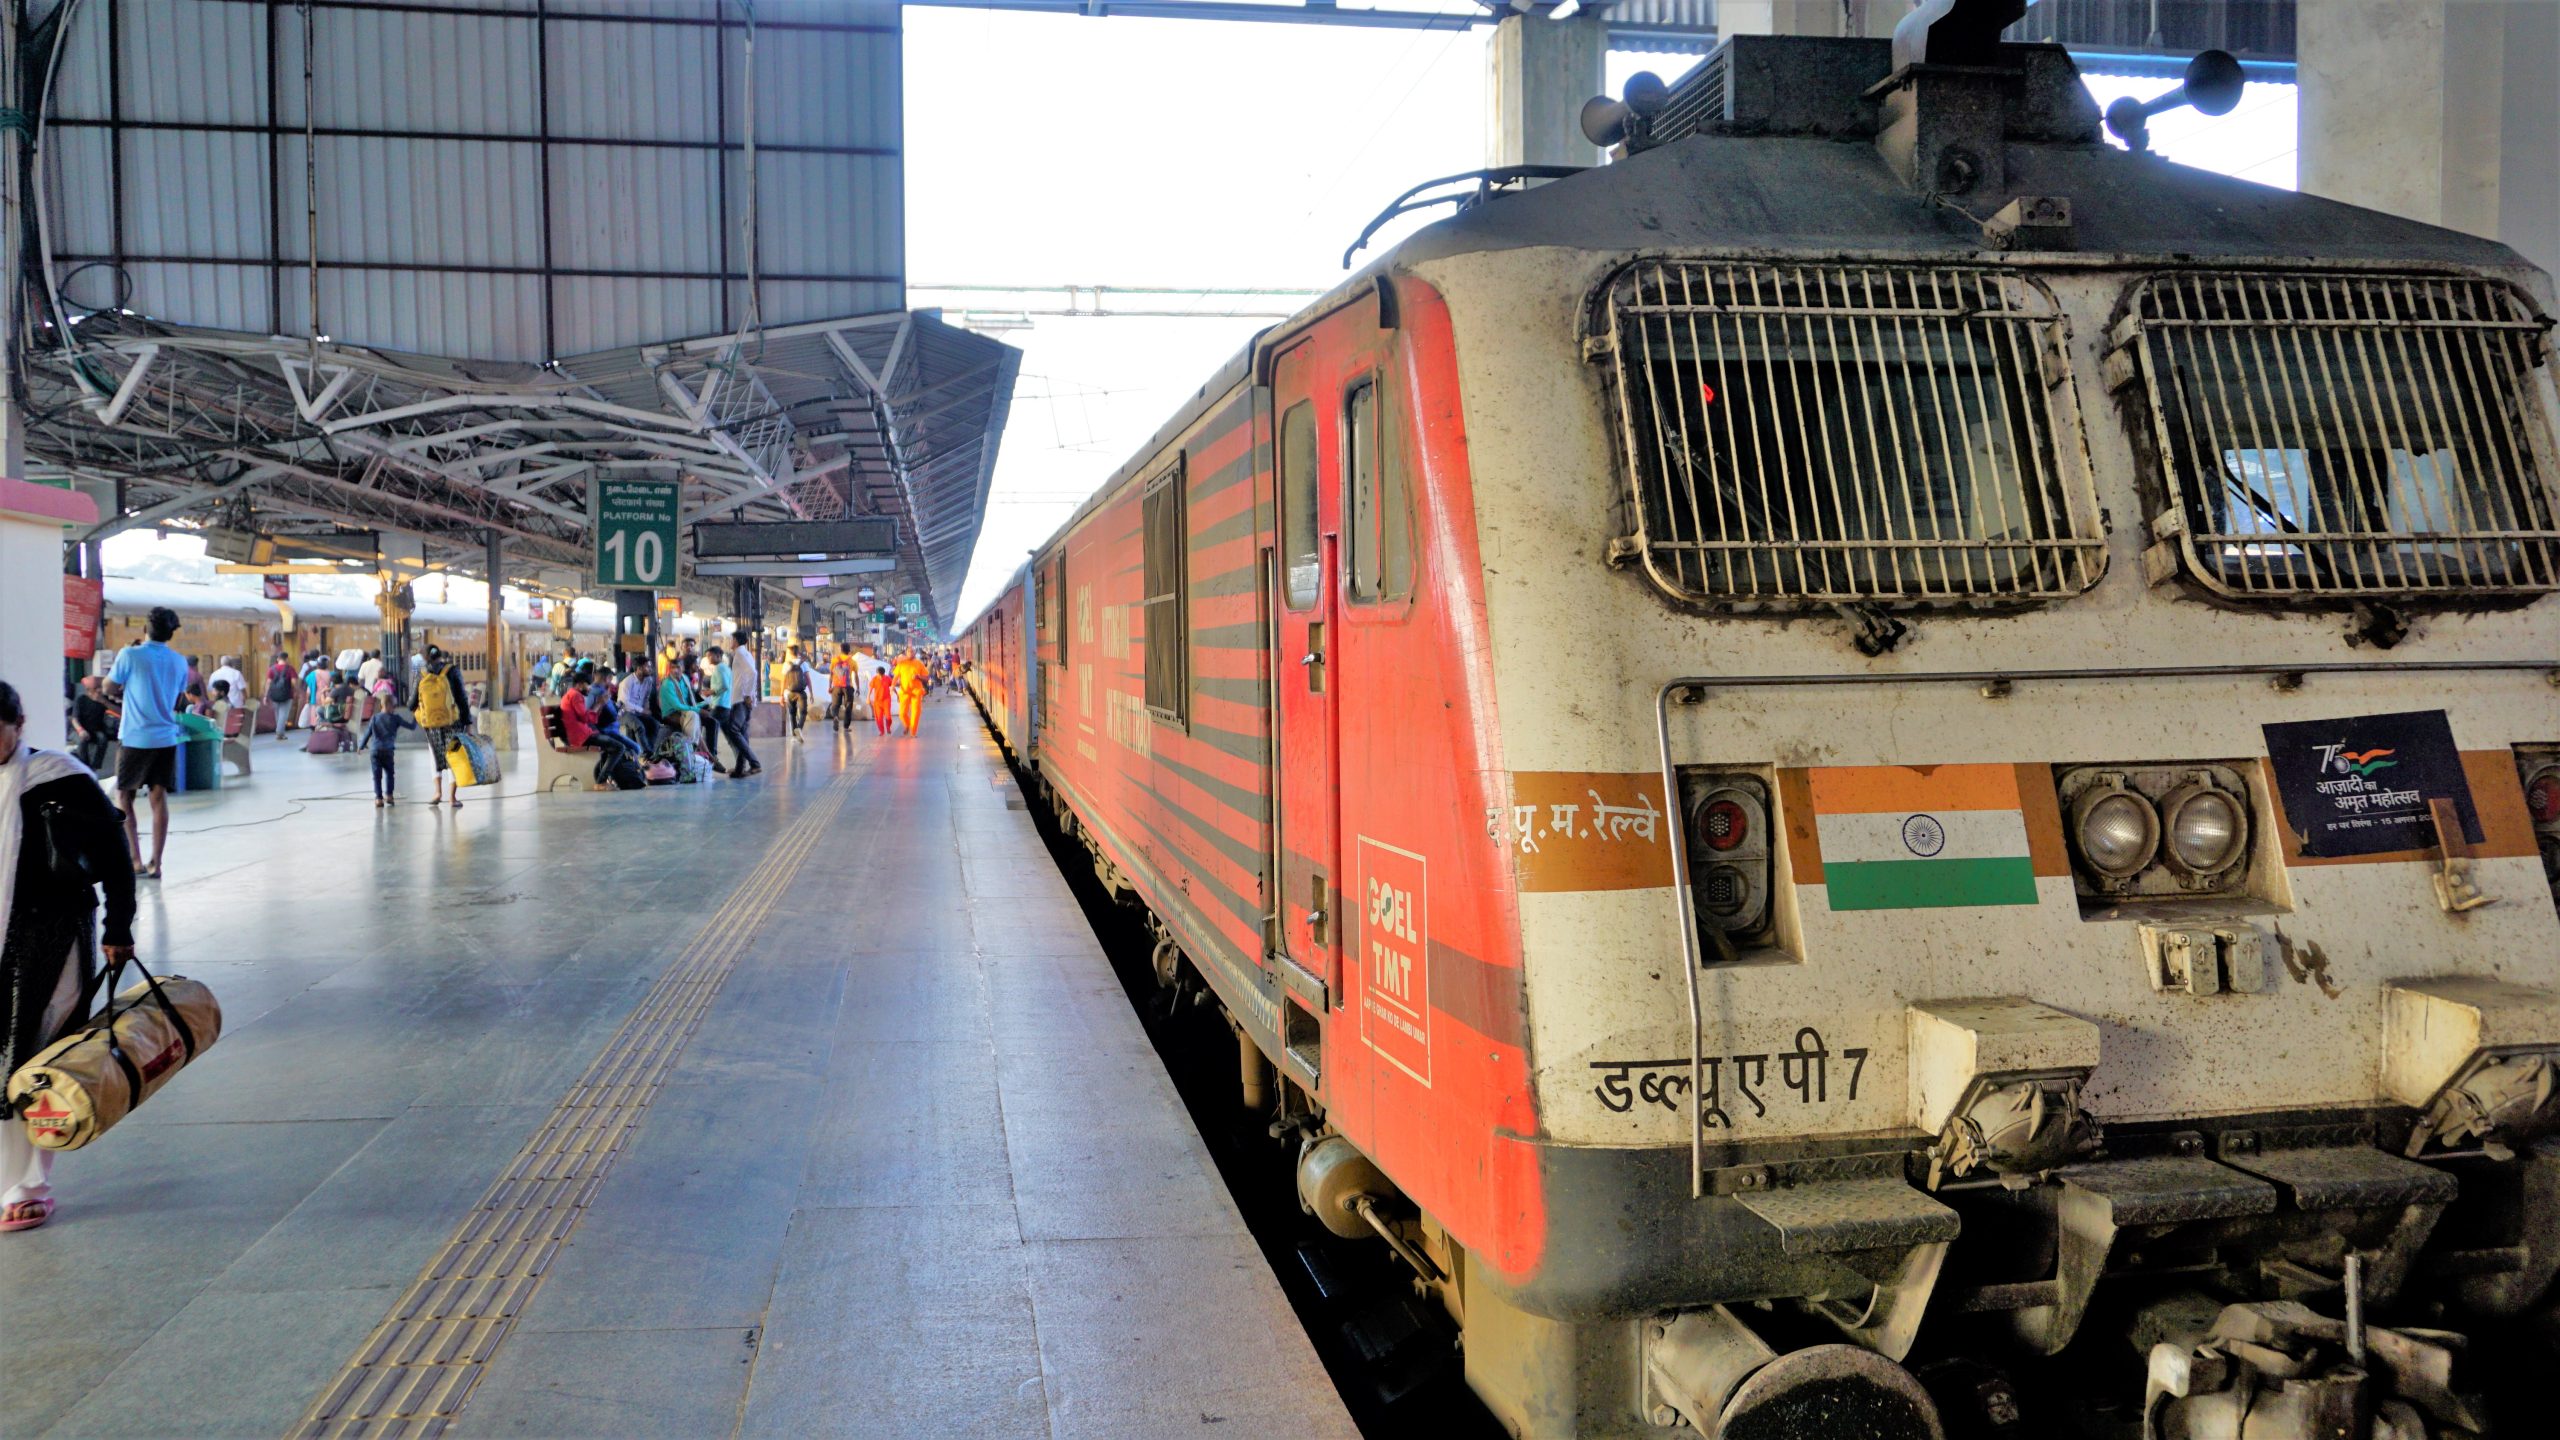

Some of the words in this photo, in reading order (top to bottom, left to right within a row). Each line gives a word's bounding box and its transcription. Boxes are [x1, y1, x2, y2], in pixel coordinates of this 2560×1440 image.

[603, 512, 654, 521] PLATFORM
[658, 513, 671, 521] No
[604, 529, 663, 583] 10
[904, 603, 917, 612] 10
[2364, 781, 2378, 791] का
[2334, 795, 2368, 813] अमृत
[2369, 788, 2421, 808] महोत्सव
[1366, 876, 1417, 945] GOEL
[1372, 940, 1412, 1002] TMT
[1393, 1014, 1400, 1029] DE
